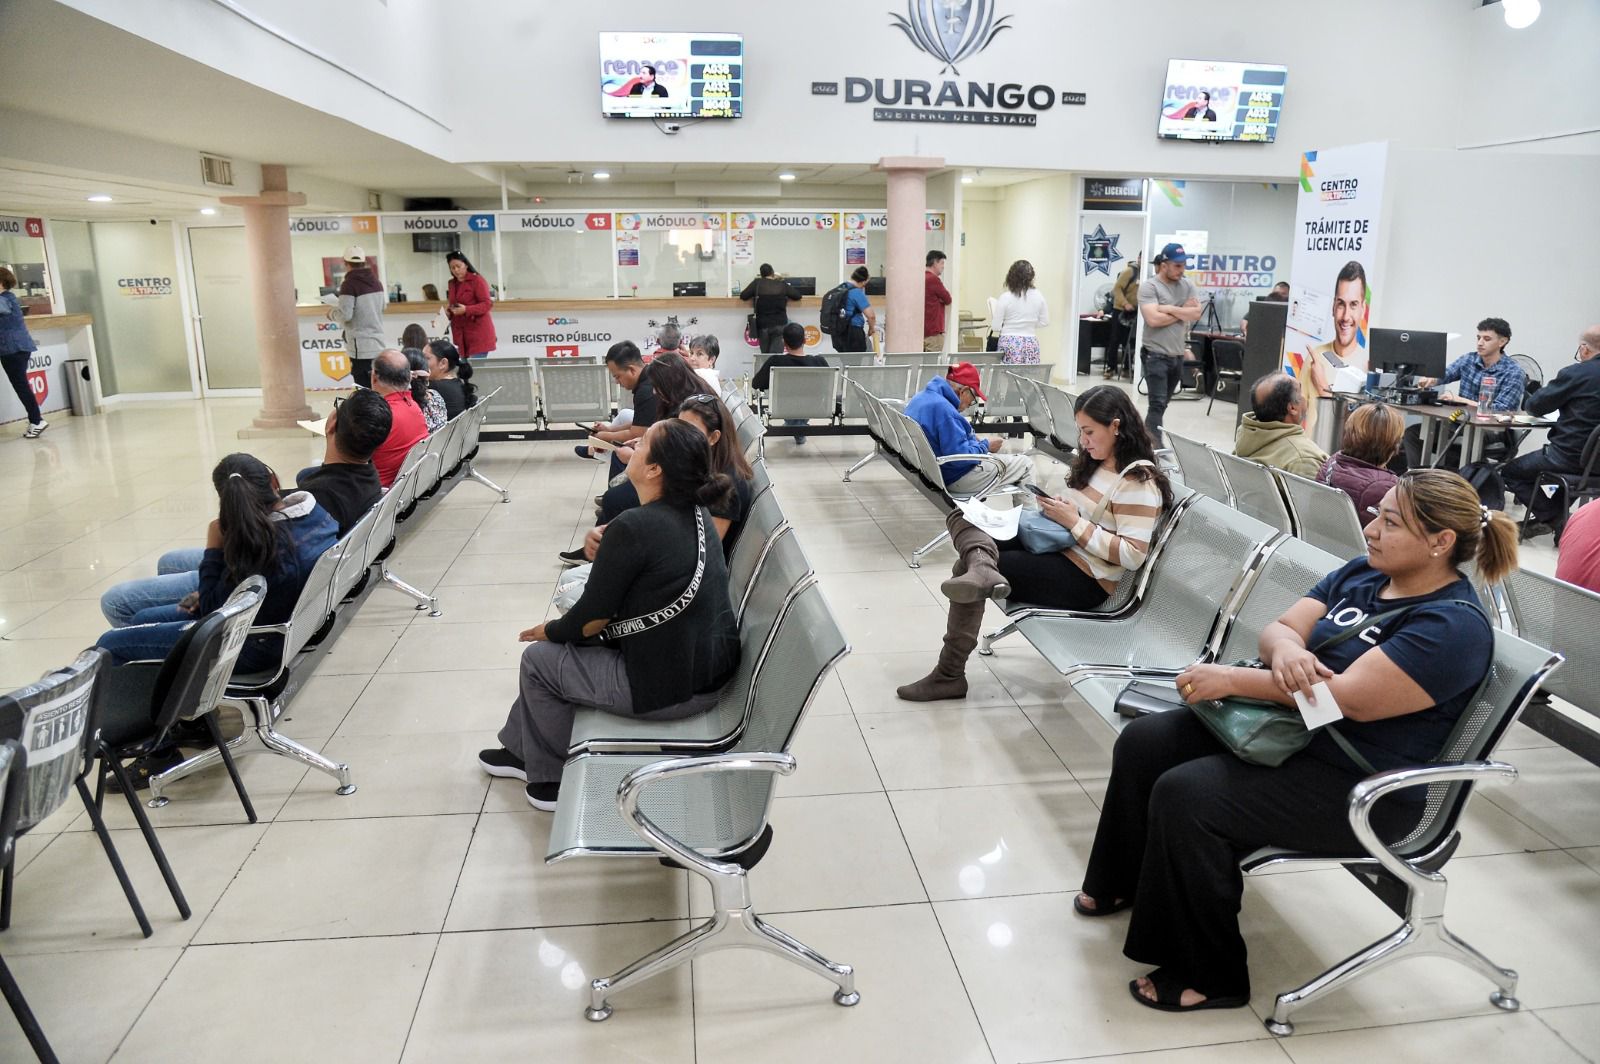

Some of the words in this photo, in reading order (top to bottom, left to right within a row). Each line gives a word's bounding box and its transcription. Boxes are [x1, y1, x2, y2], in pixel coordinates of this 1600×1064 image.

[845, 76, 1056, 111] DURANGO
[953, 113, 977, 122] DEL
[984, 115, 1037, 125] ESTADO
[1321, 178, 1358, 191] CENTRO
[357, 220, 369, 230] 11
[403, 215, 458, 230] MÓDULO
[475, 218, 489, 228] 12
[521, 214, 575, 228] MÓDULO
[592, 217, 606, 227] 13
[646, 213, 697, 227] MÓDULO
[708, 217, 720, 226] 14
[760, 213, 810, 227] MÓDULO
[821, 217, 833, 226] 15
[929, 216, 941, 226] 16
[1305, 216, 1352, 235] TRÁMITE
[1353, 218, 1369, 234] DE
[29, 223, 40, 234] 10
[1307, 236, 1363, 252] LICENCIAS
[1185, 254, 1276, 272] CENTRO
[117, 277, 171, 288] CENTRO
[302, 338, 344, 350] CATAS
[512, 333, 564, 344] REGISTRO
[566, 330, 612, 343] PÚBLICO
[28, 354, 52, 369] DULO
[327, 355, 345, 371] 11
[28, 375, 45, 395] 10
